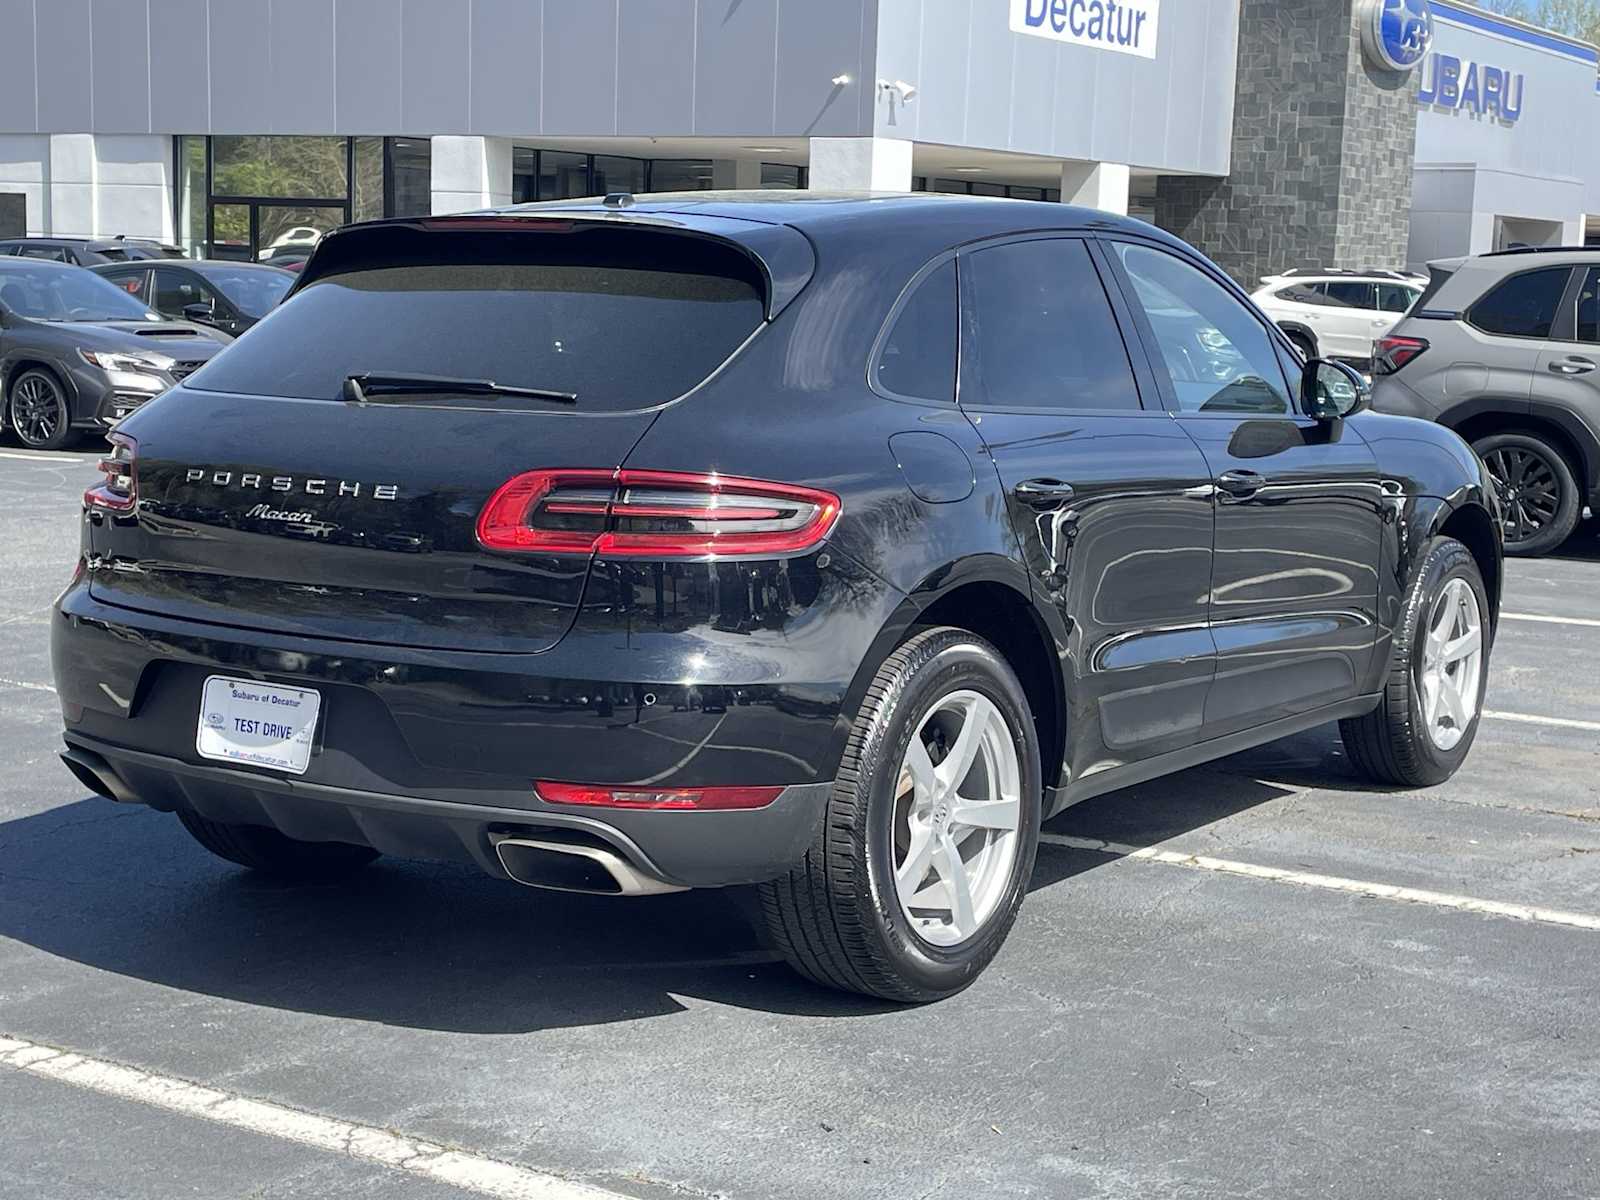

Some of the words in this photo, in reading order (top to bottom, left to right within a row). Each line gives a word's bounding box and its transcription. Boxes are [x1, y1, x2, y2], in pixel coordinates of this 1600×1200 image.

[1025, 0, 1147, 48] Decatur
[1417, 53, 1524, 122] UBARU
[185, 468, 398, 501] PORSCHE
[245, 503, 313, 524] Macan
[231, 689, 260, 702] Subaru
[261, 694, 270, 703] of
[271, 695, 301, 708] Decatur
[234, 718, 260, 735] TEST
[263, 722, 293, 740] DRIVE
